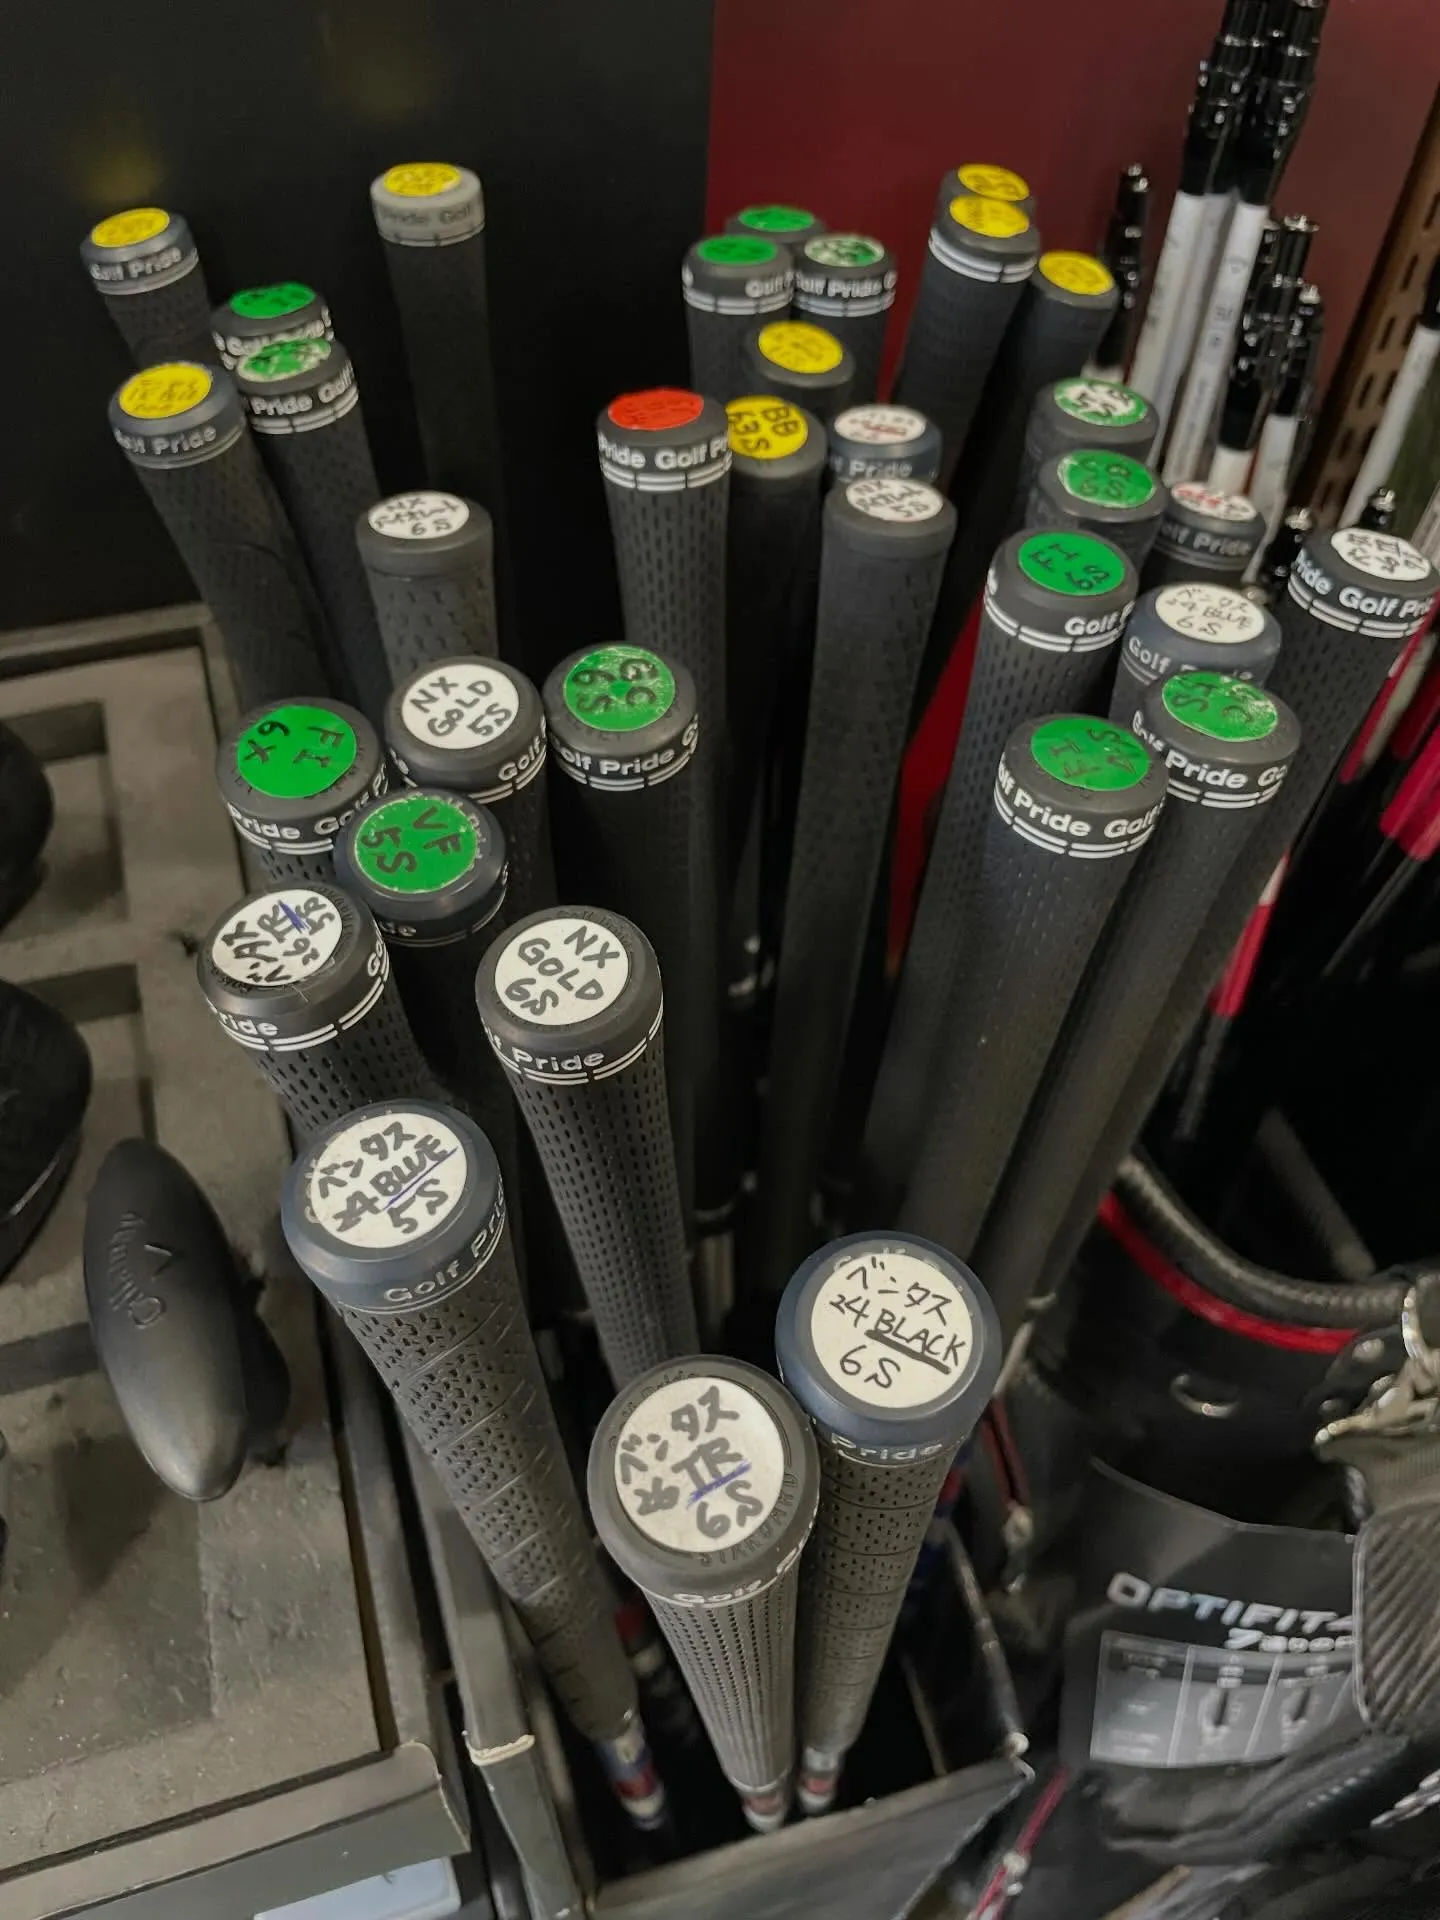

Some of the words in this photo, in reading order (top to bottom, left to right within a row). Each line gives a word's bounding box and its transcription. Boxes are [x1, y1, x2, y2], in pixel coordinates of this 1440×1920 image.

[655, 444, 708, 470] Golf
[1338, 586, 1400, 618] Golf
[1064, 611, 1119, 636] Golf
[1128, 635, 1172, 674] Golf
[409, 675, 460, 715] NX
[497, 735, 542, 781] Golf
[599, 748, 676, 776] Pride
[1164, 750, 1249, 789] Pride
[226, 801, 301, 840] Pride
[1013, 788, 1093, 838] Pride
[562, 924, 622, 969] NX
[516, 937, 605, 1001] GOLD
[503, 977, 561, 1017] 6S
[511, 1045, 605, 1072] Pride
[368, 1133, 450, 1197] BLUE
[383, 1258, 461, 1302] Golf
[872, 1307, 967, 1367] BLACK
